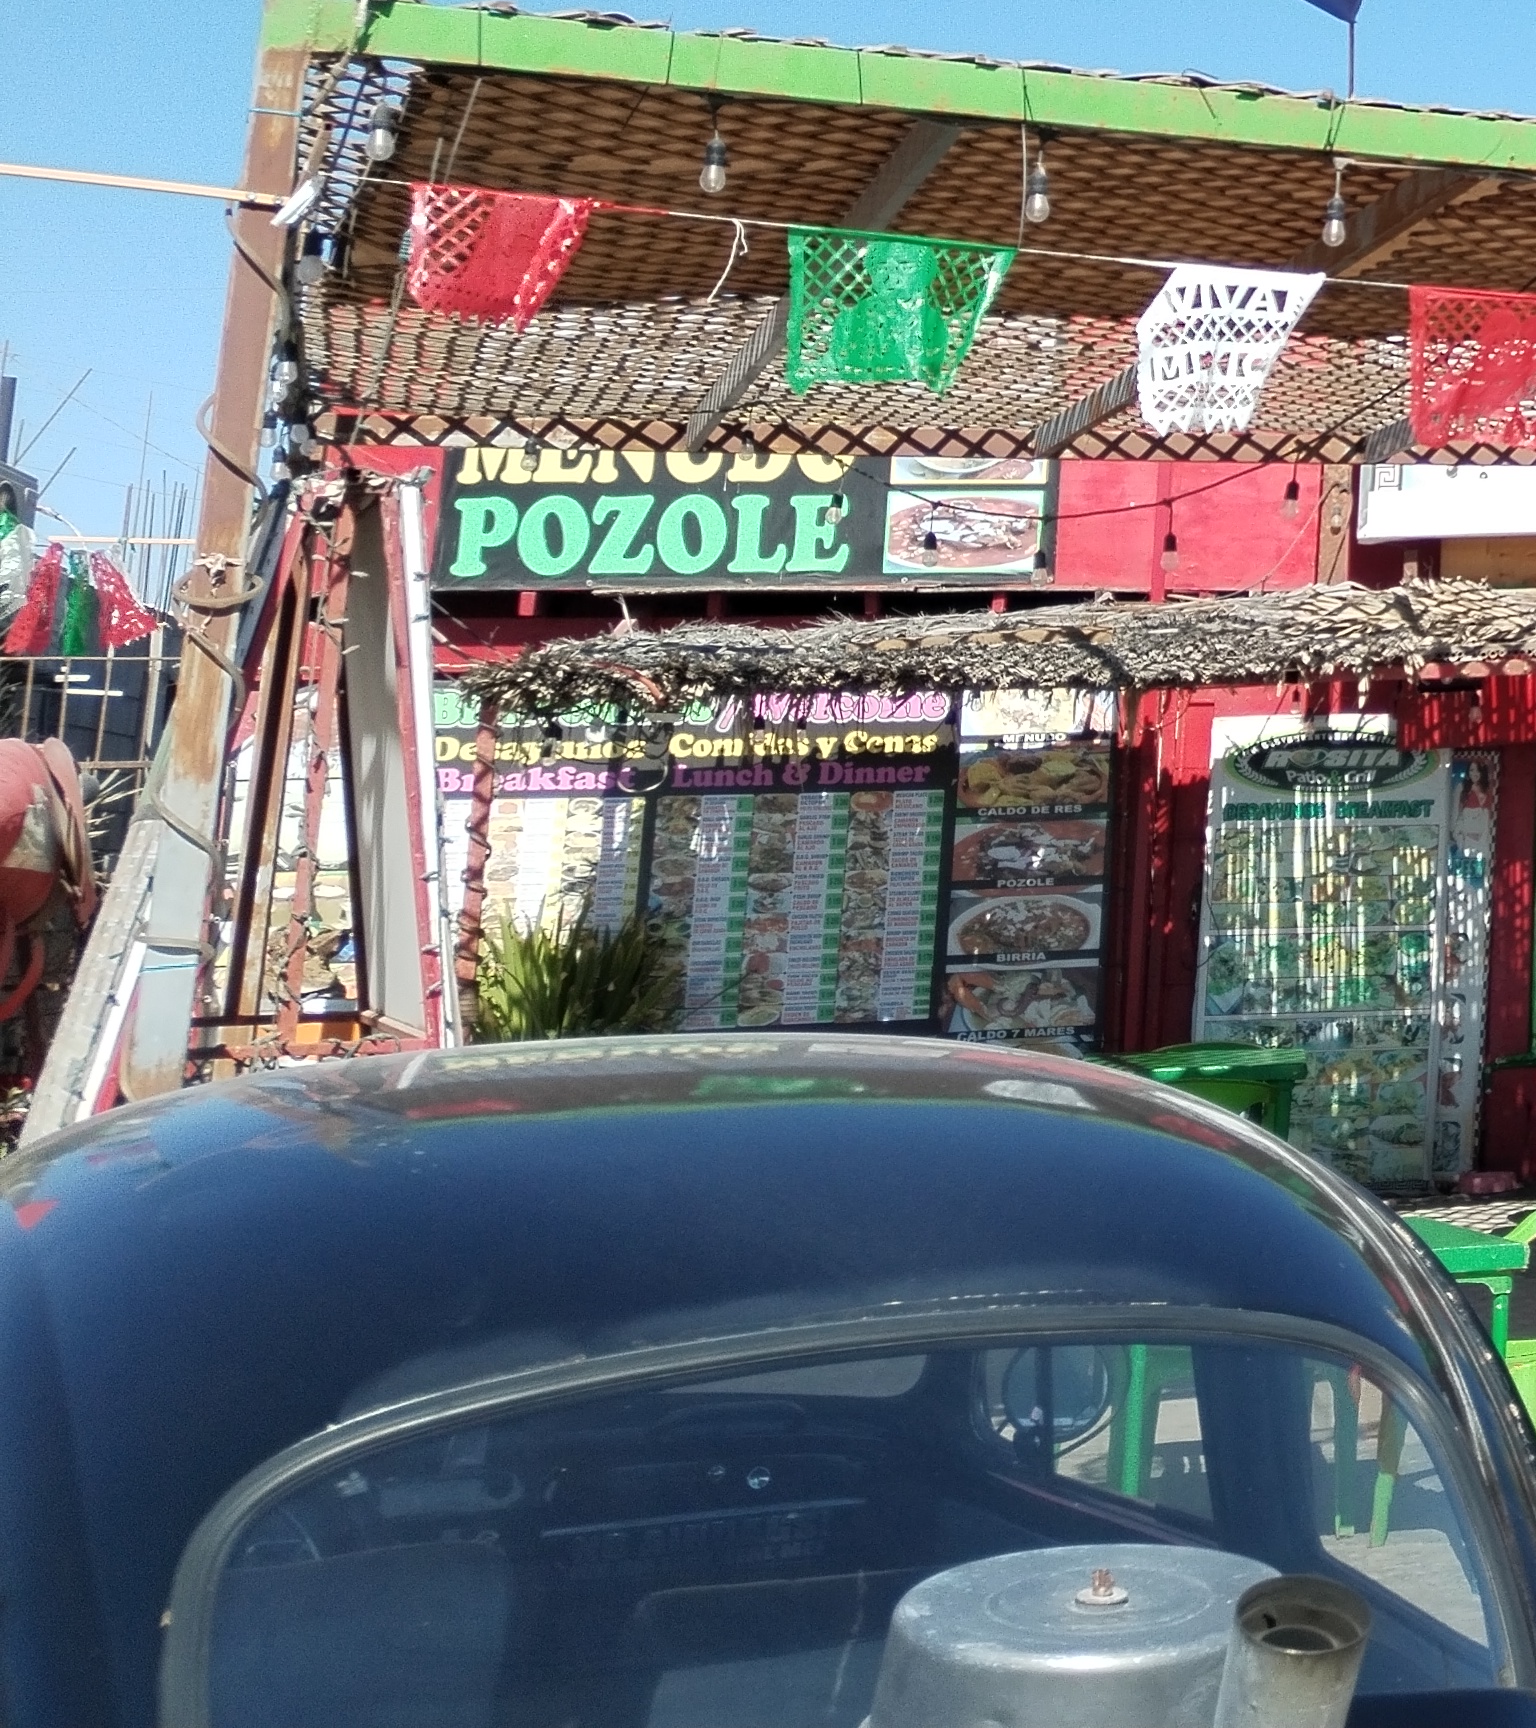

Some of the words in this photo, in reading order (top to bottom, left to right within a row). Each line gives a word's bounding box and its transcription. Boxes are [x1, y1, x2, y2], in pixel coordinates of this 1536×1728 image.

[449, 493, 850, 576] POZOLE
[817, 736, 838, 760] y
[844, 730, 938, 754] Cenas
[671, 765, 774, 788] Lunch
[782, 763, 809, 786] &
[817, 761, 931, 785] Dinner
[1286, 769, 1325, 784] Patio
[1329, 770, 1341, 785] &
[977, 806, 1027, 816] CALDO
[1031, 805, 1050, 815] DE
[1054, 804, 1082, 813] RES
[1335, 799, 1435, 819] BREAKFAST
[997, 877, 1055, 888] POZOLE
[996, 951, 1047, 962] BIRRIA
[956, 1029, 1007, 1042] CALDO
[1011, 1028, 1021, 1038] 7
[1024, 1026, 1075, 1037] MARES
